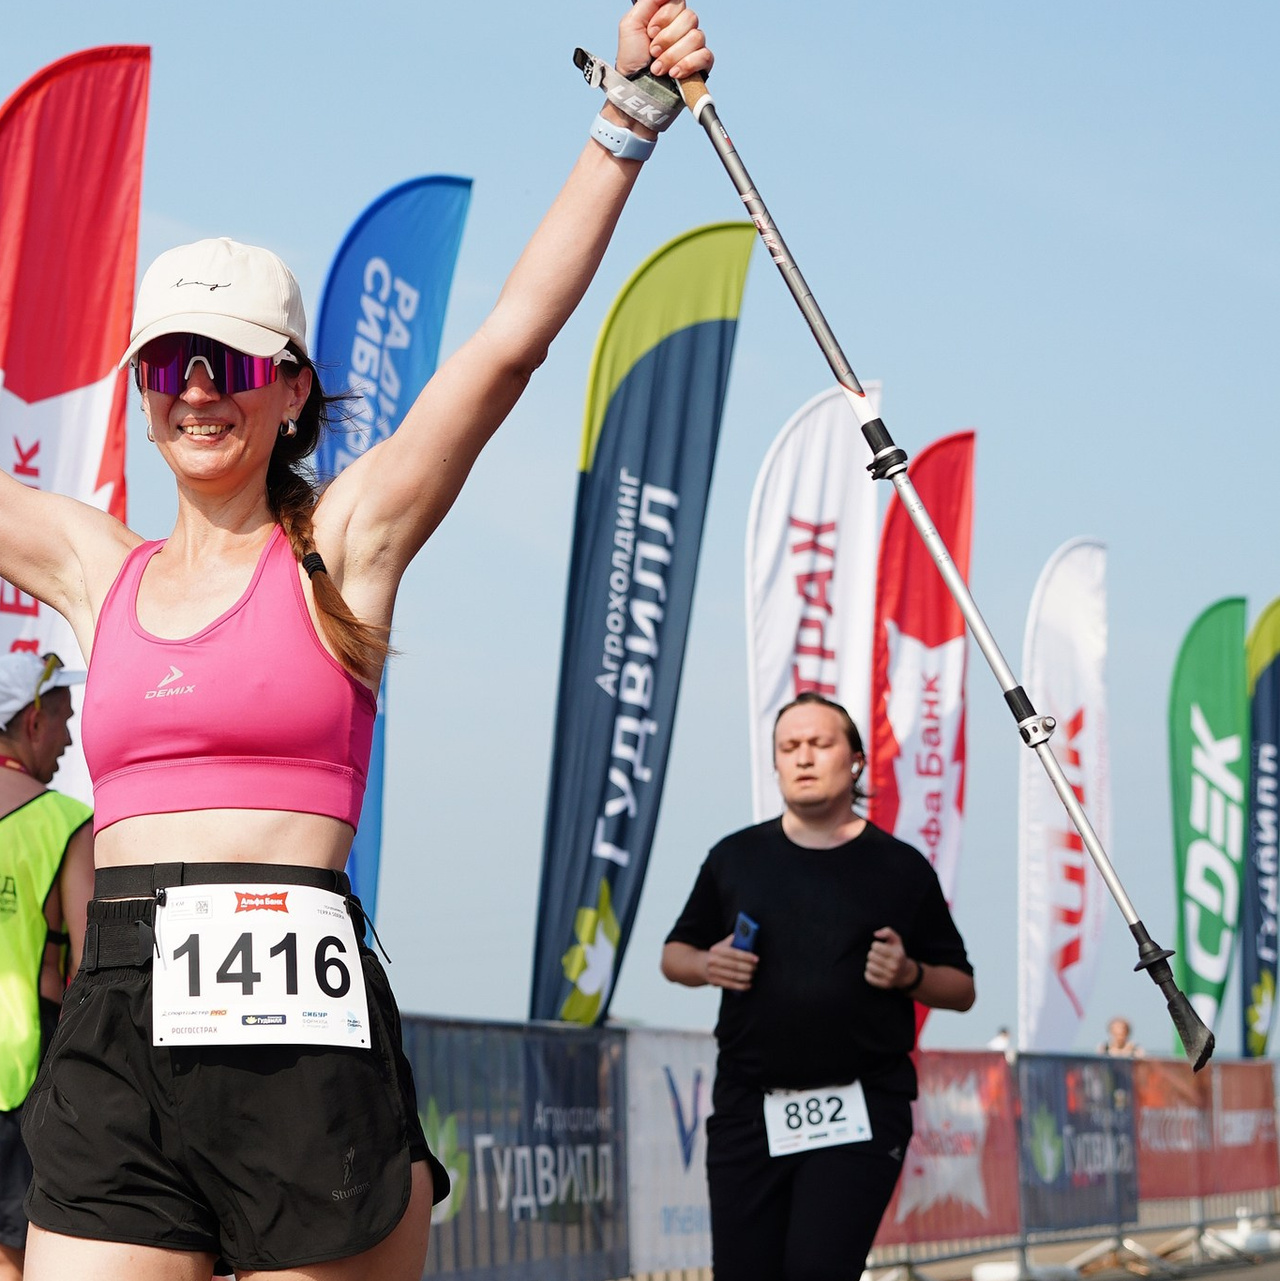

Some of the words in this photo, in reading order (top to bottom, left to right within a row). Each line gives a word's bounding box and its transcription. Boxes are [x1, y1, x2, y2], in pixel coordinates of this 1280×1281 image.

[608, 84, 670, 125] LEKI
[372, 276, 420, 440] РАДИ
[593, 467, 641, 698] Агрохолдинг
[144, 684, 196, 700] DEMIX
[1183, 701, 1245, 984] CDEK
[240, 897, 265, 909] Альфа
[265, 897, 284, 907] Банк
[172, 931, 351, 1000] 1416
[171, 1026, 218, 1034] РОСГОССТРАХ
[785, 1096, 847, 1130] 882
